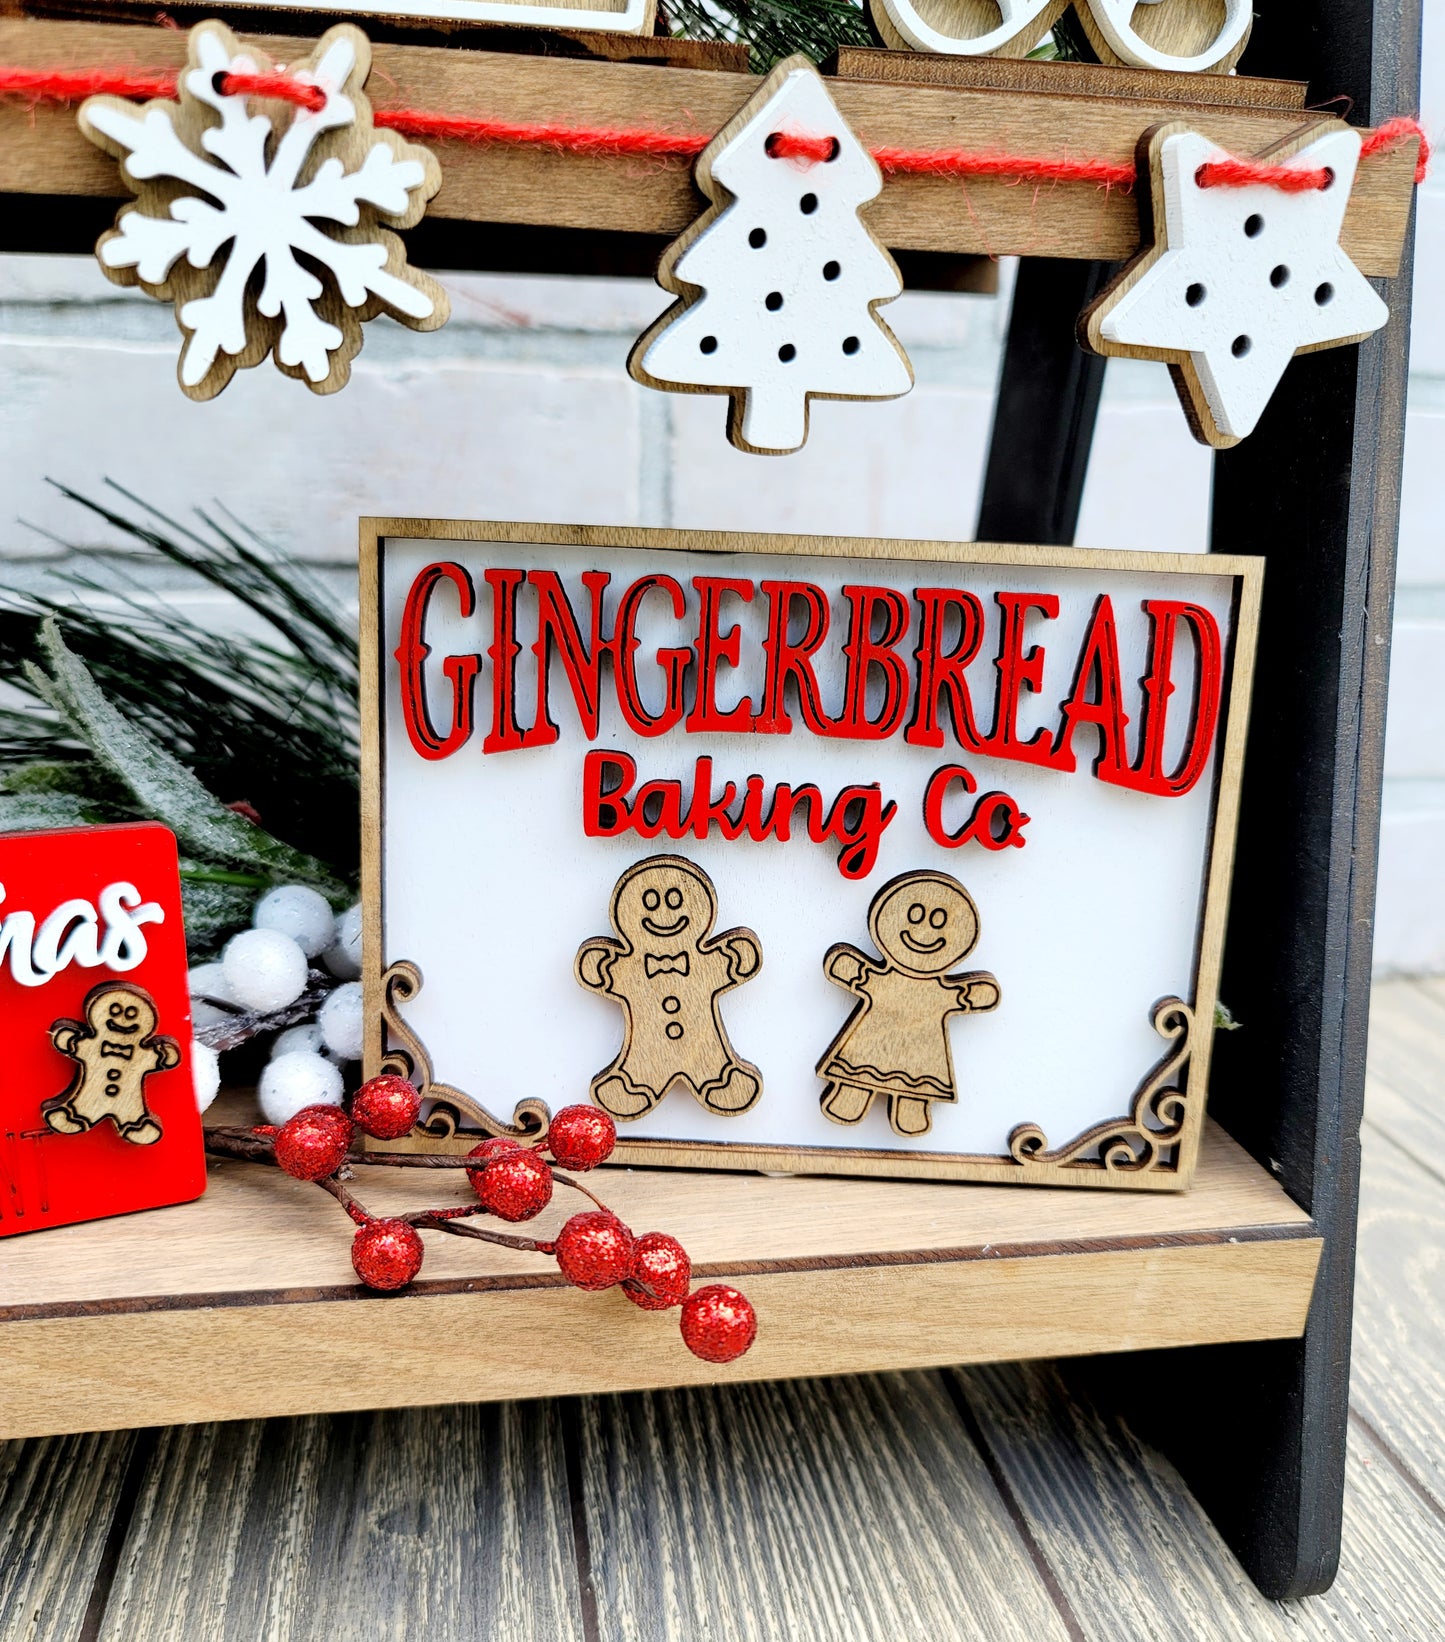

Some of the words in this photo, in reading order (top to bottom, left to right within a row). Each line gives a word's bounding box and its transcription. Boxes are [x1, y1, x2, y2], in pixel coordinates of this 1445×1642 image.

[394, 562, 1222, 797] GINGERBREAD
[583, 751, 898, 879] Baking
[925, 765, 1031, 850] Co
